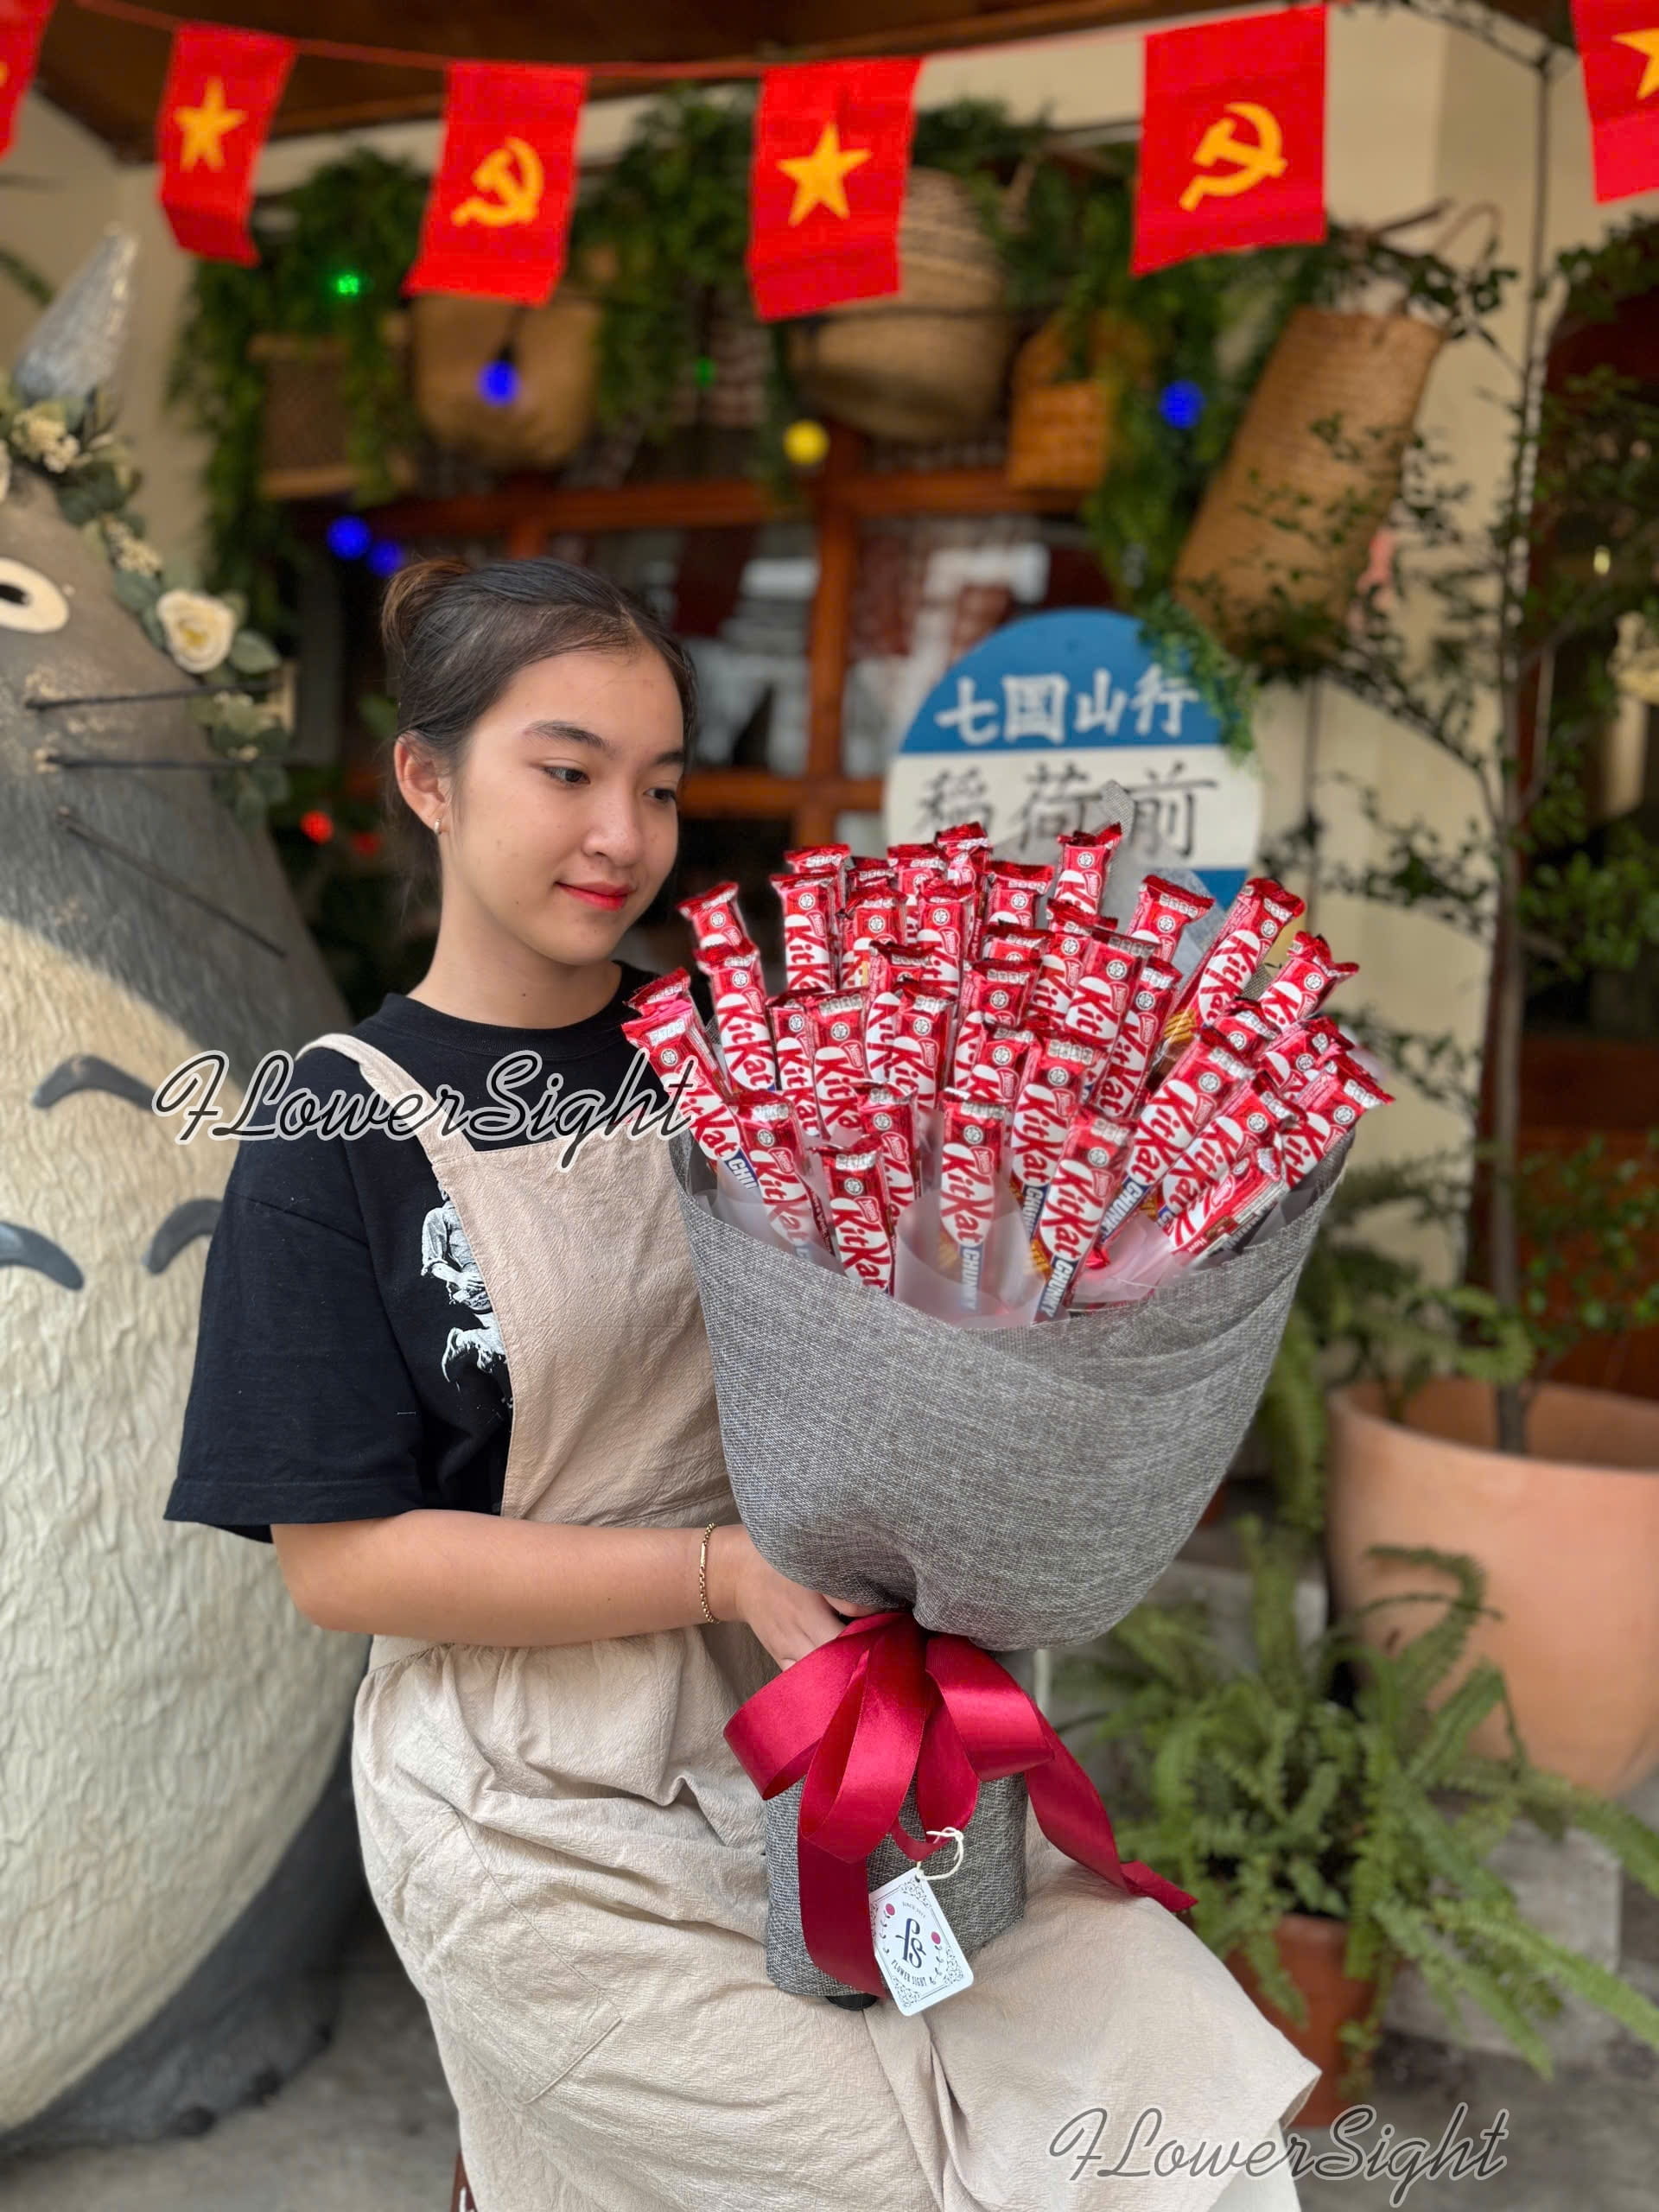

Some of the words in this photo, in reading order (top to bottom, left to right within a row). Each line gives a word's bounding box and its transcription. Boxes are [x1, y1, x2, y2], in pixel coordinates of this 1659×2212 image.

[717, 1003, 774, 1087] KitKat
[1012, 1090, 1068, 1186] KitKat
[1133, 1085, 1198, 1183] KitKat
[941, 1154, 993, 1245] KitKat
[1040, 1168, 1105, 1262] KitKat
[832, 1209, 891, 1289] KitKat
